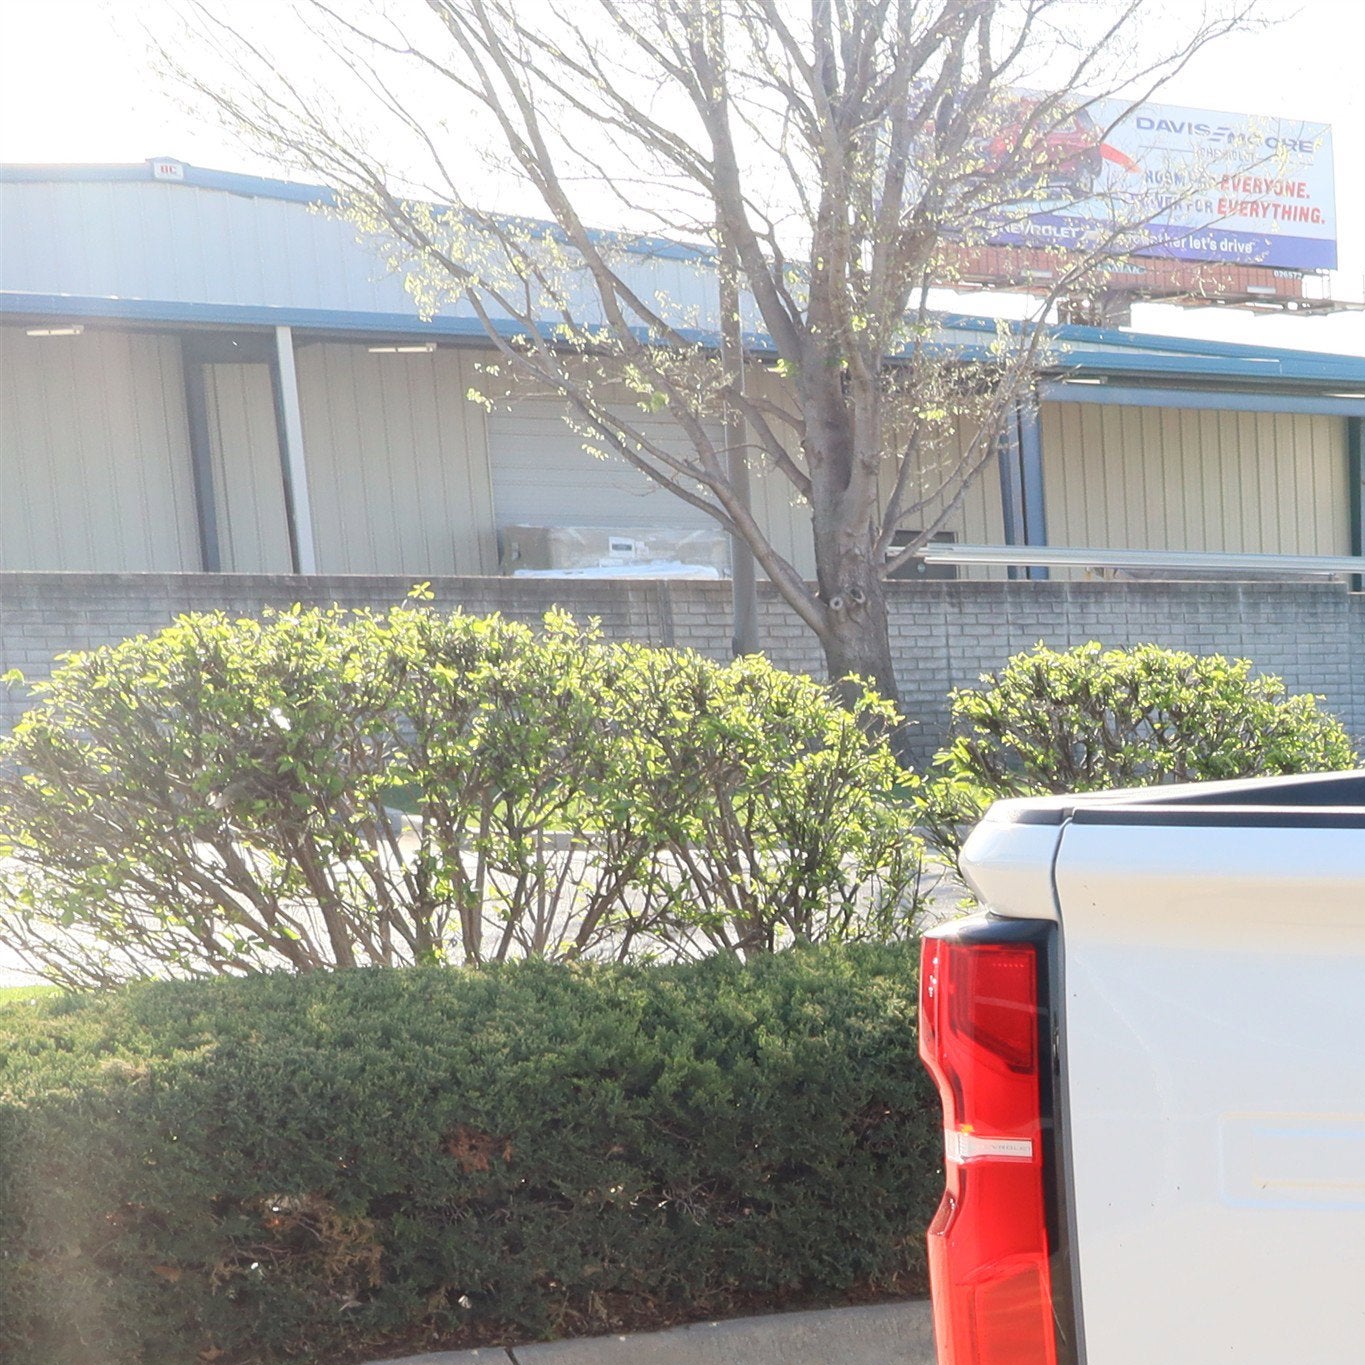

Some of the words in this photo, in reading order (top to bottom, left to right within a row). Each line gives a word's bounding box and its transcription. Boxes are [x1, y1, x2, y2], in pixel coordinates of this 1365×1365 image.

[1135, 116, 1211, 137] DAVIS
[1220, 174, 1311, 199] EVERYONE.
[1217, 197, 1325, 224] EVERYTHING.
[987, 221, 1080, 238] HEVROLET
[1189, 233, 1217, 251] let's
[1219, 237, 1252, 254] drive
